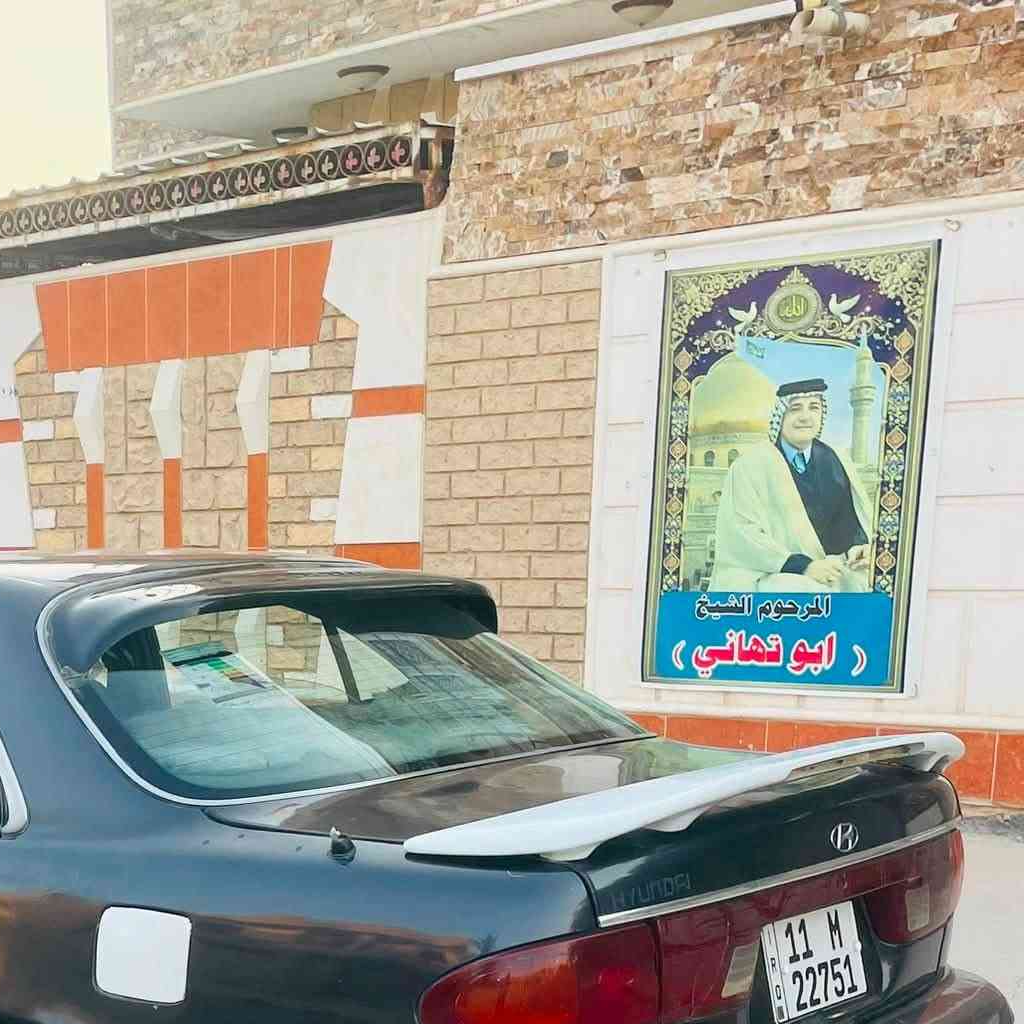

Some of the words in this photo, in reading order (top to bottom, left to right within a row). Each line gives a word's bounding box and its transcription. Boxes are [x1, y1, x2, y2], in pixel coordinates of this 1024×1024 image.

[695, 594, 752, 620] الشيخ
[758, 594, 831, 622] المرحوم
[785, 918, 813, 964] 11
[827, 909, 843, 950] M
[792, 954, 858, 1012] 22751
